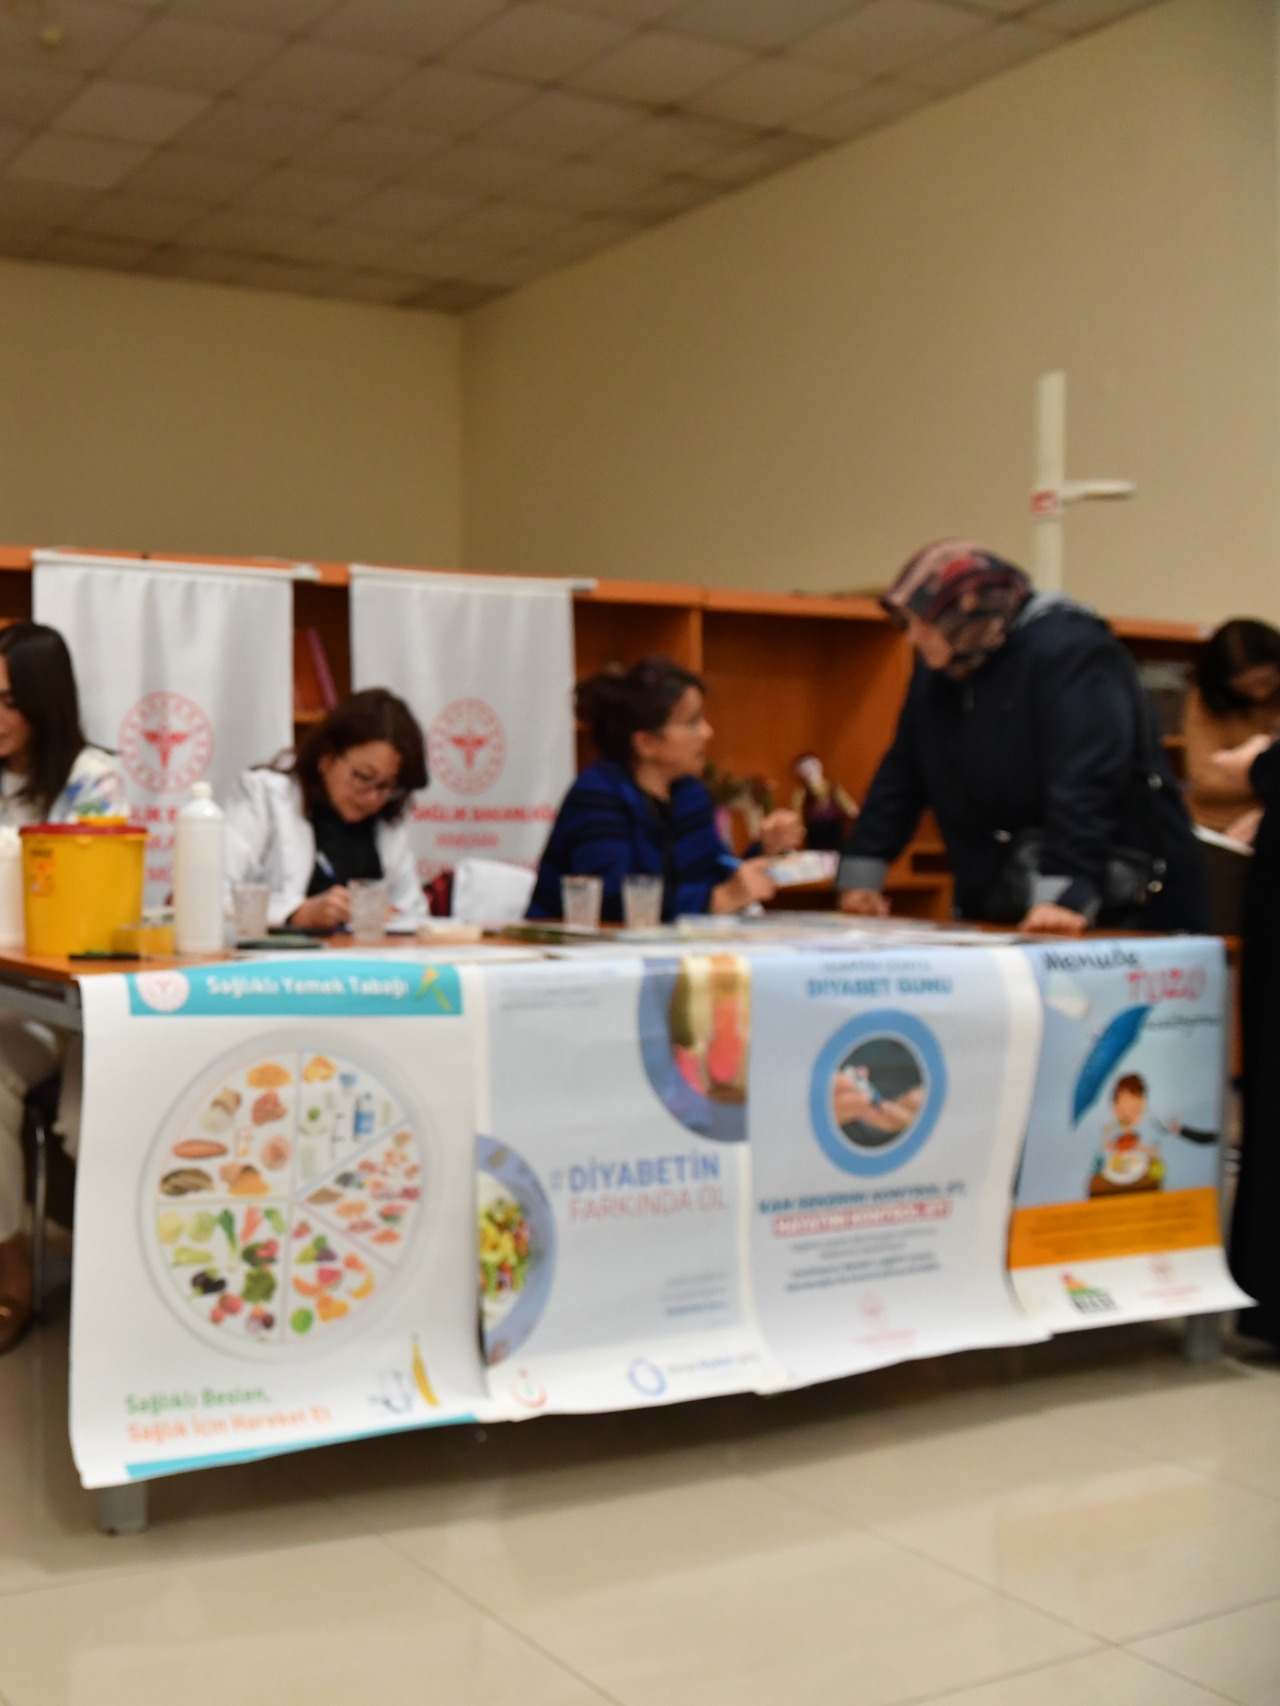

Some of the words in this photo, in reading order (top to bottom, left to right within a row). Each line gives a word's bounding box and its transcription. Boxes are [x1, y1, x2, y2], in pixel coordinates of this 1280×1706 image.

[206, 975, 279, 999] Sağlıklı
[281, 975, 345, 996] Yemek
[348, 975, 409, 999] Tabağı
[551, 1152, 719, 1192] #DİYABETİN
[570, 1187, 693, 1222] FARKINDA
[697, 1184, 726, 1213] OL
